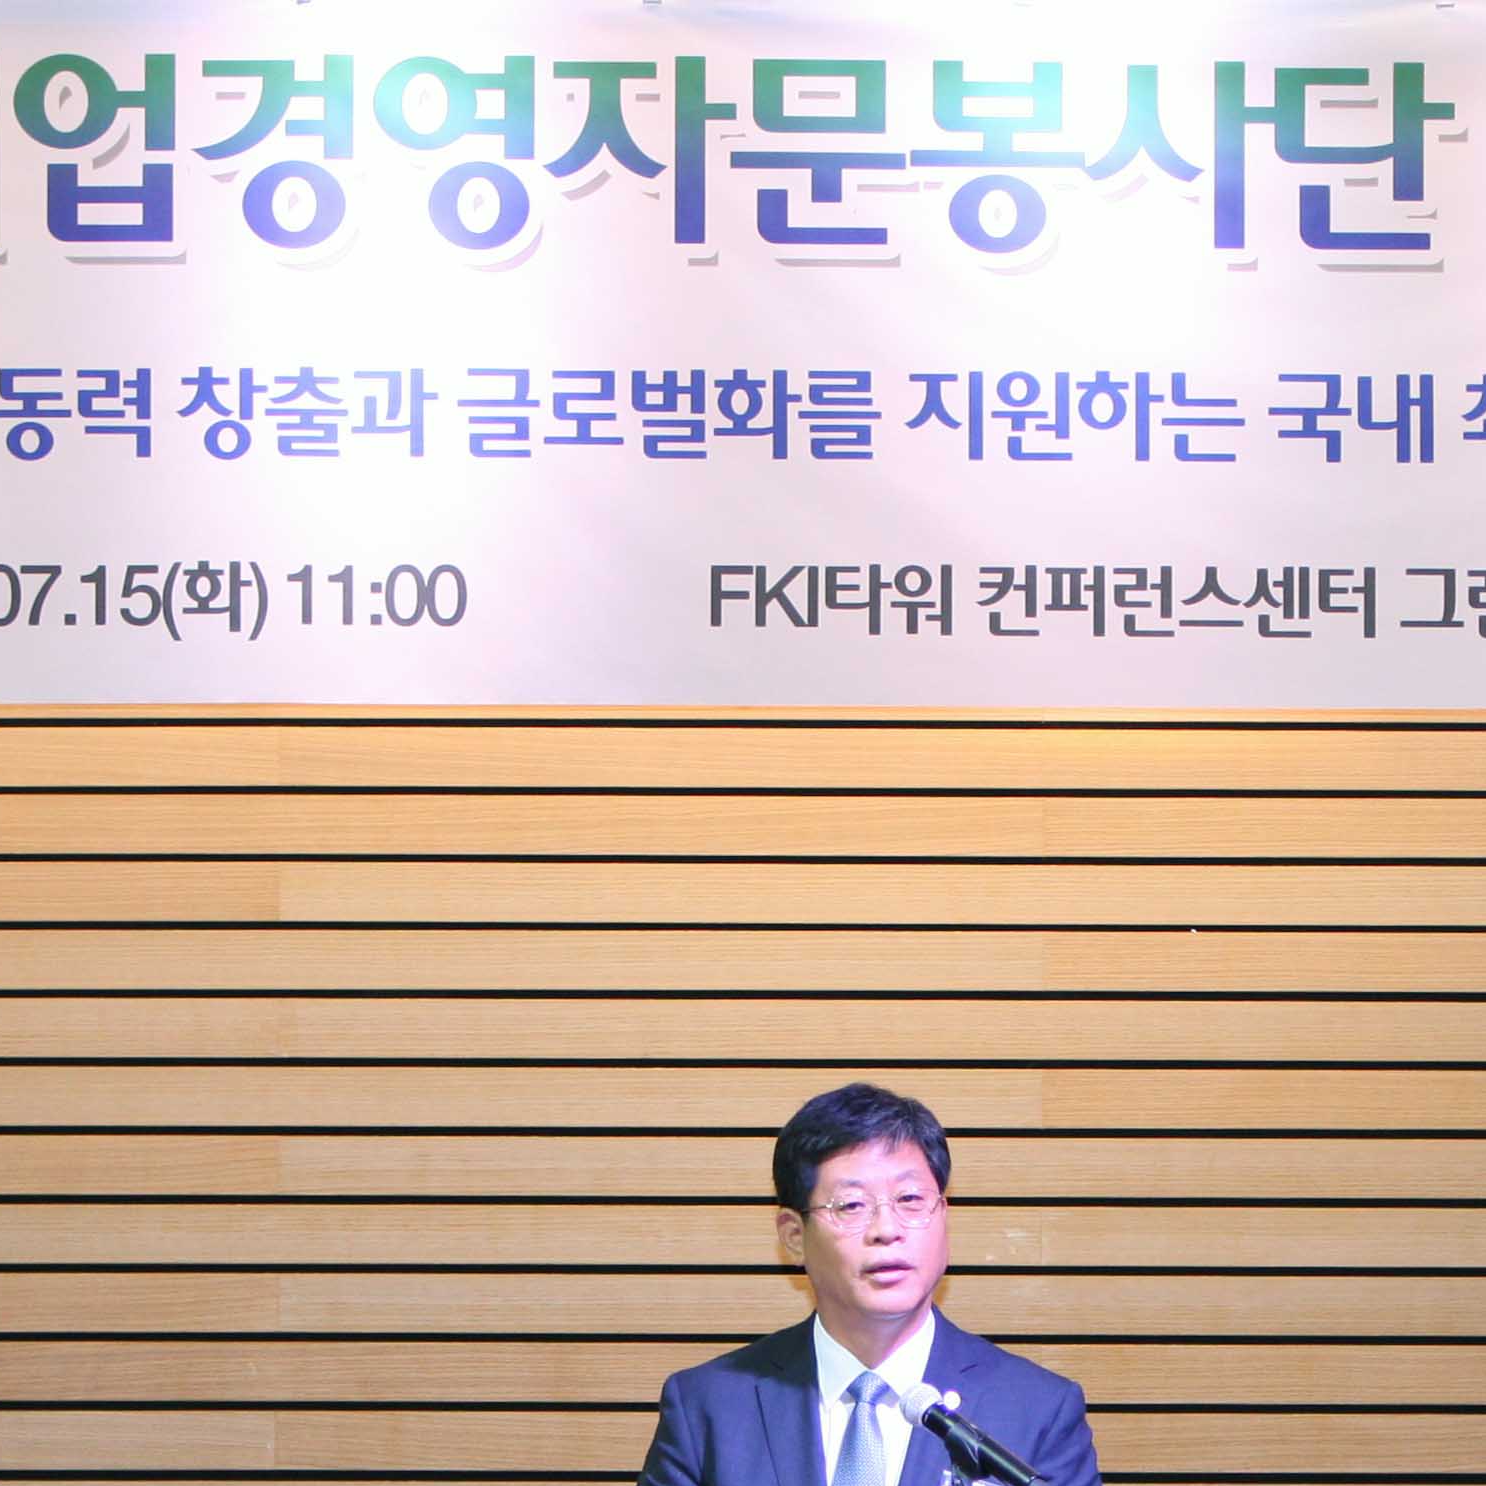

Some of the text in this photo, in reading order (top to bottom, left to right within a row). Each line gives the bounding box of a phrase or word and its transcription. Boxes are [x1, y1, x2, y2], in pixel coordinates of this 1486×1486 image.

[176, 367, 438, 459] 창출과
[456, 367, 884, 461] 글로벌화를
[904, 369, 1246, 464] 지원하는
[1268, 370, 1436, 465] 국내
[287, 563, 467, 628] 11:00
[710, 563, 954, 637] FKI타워
[977, 564, 1378, 640] 컨퍼런스센터
